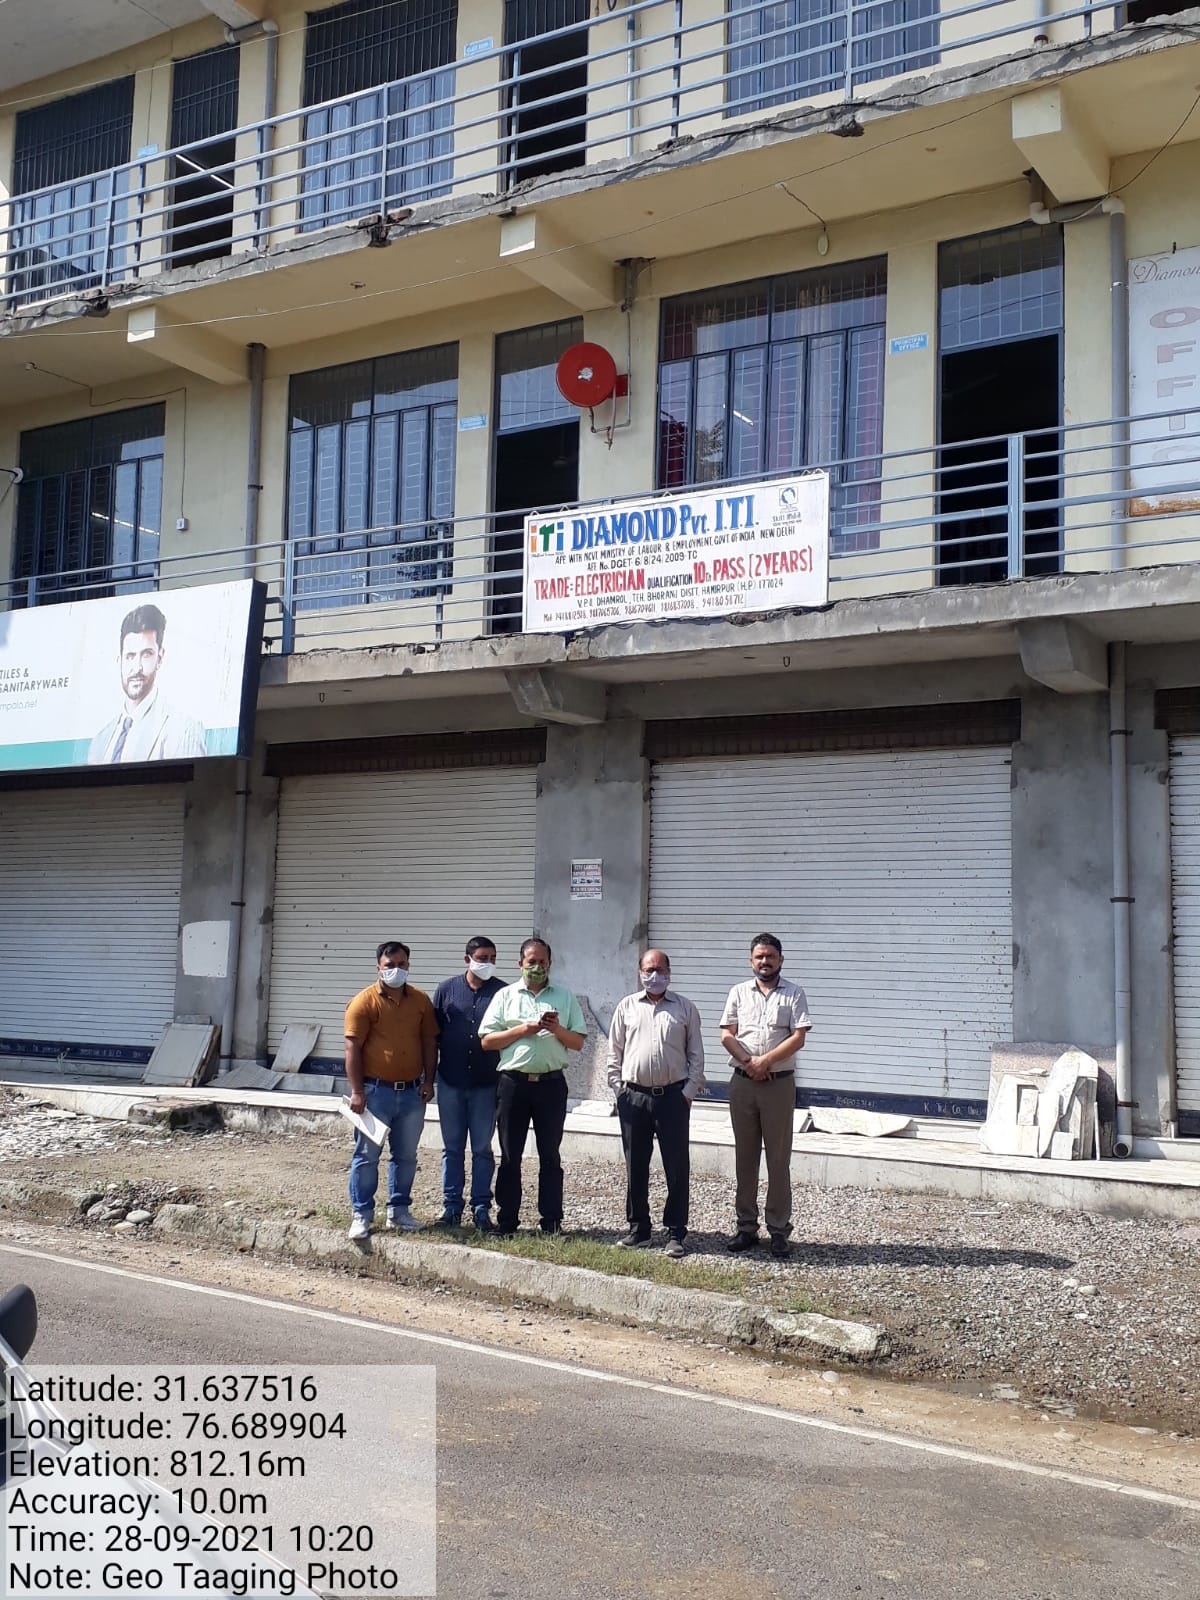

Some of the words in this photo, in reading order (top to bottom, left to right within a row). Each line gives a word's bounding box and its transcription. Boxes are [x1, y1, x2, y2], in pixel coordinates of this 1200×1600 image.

[569, 553, 583, 564] WITH
[600, 547, 626, 560] MINISTRY
[627, 545, 636, 557] OF
[638, 543, 662, 555] LABOUR
[665, 542, 670, 551] &
[731, 532, 739, 543] OF
[739, 530, 755, 541] INDIA
[760, 528, 775, 539] NEW
[776, 525, 795, 537] DELHI
[571, 506, 677, 551] DIAMOND
[574, 568, 645, 597] ELECTRICIAN
[647, 573, 693, 590] QUALIFICATION
[713, 556, 746, 581] PASS
[701, 582, 735, 595] HAMIRPUR
[23, 667, 29, 678] &
